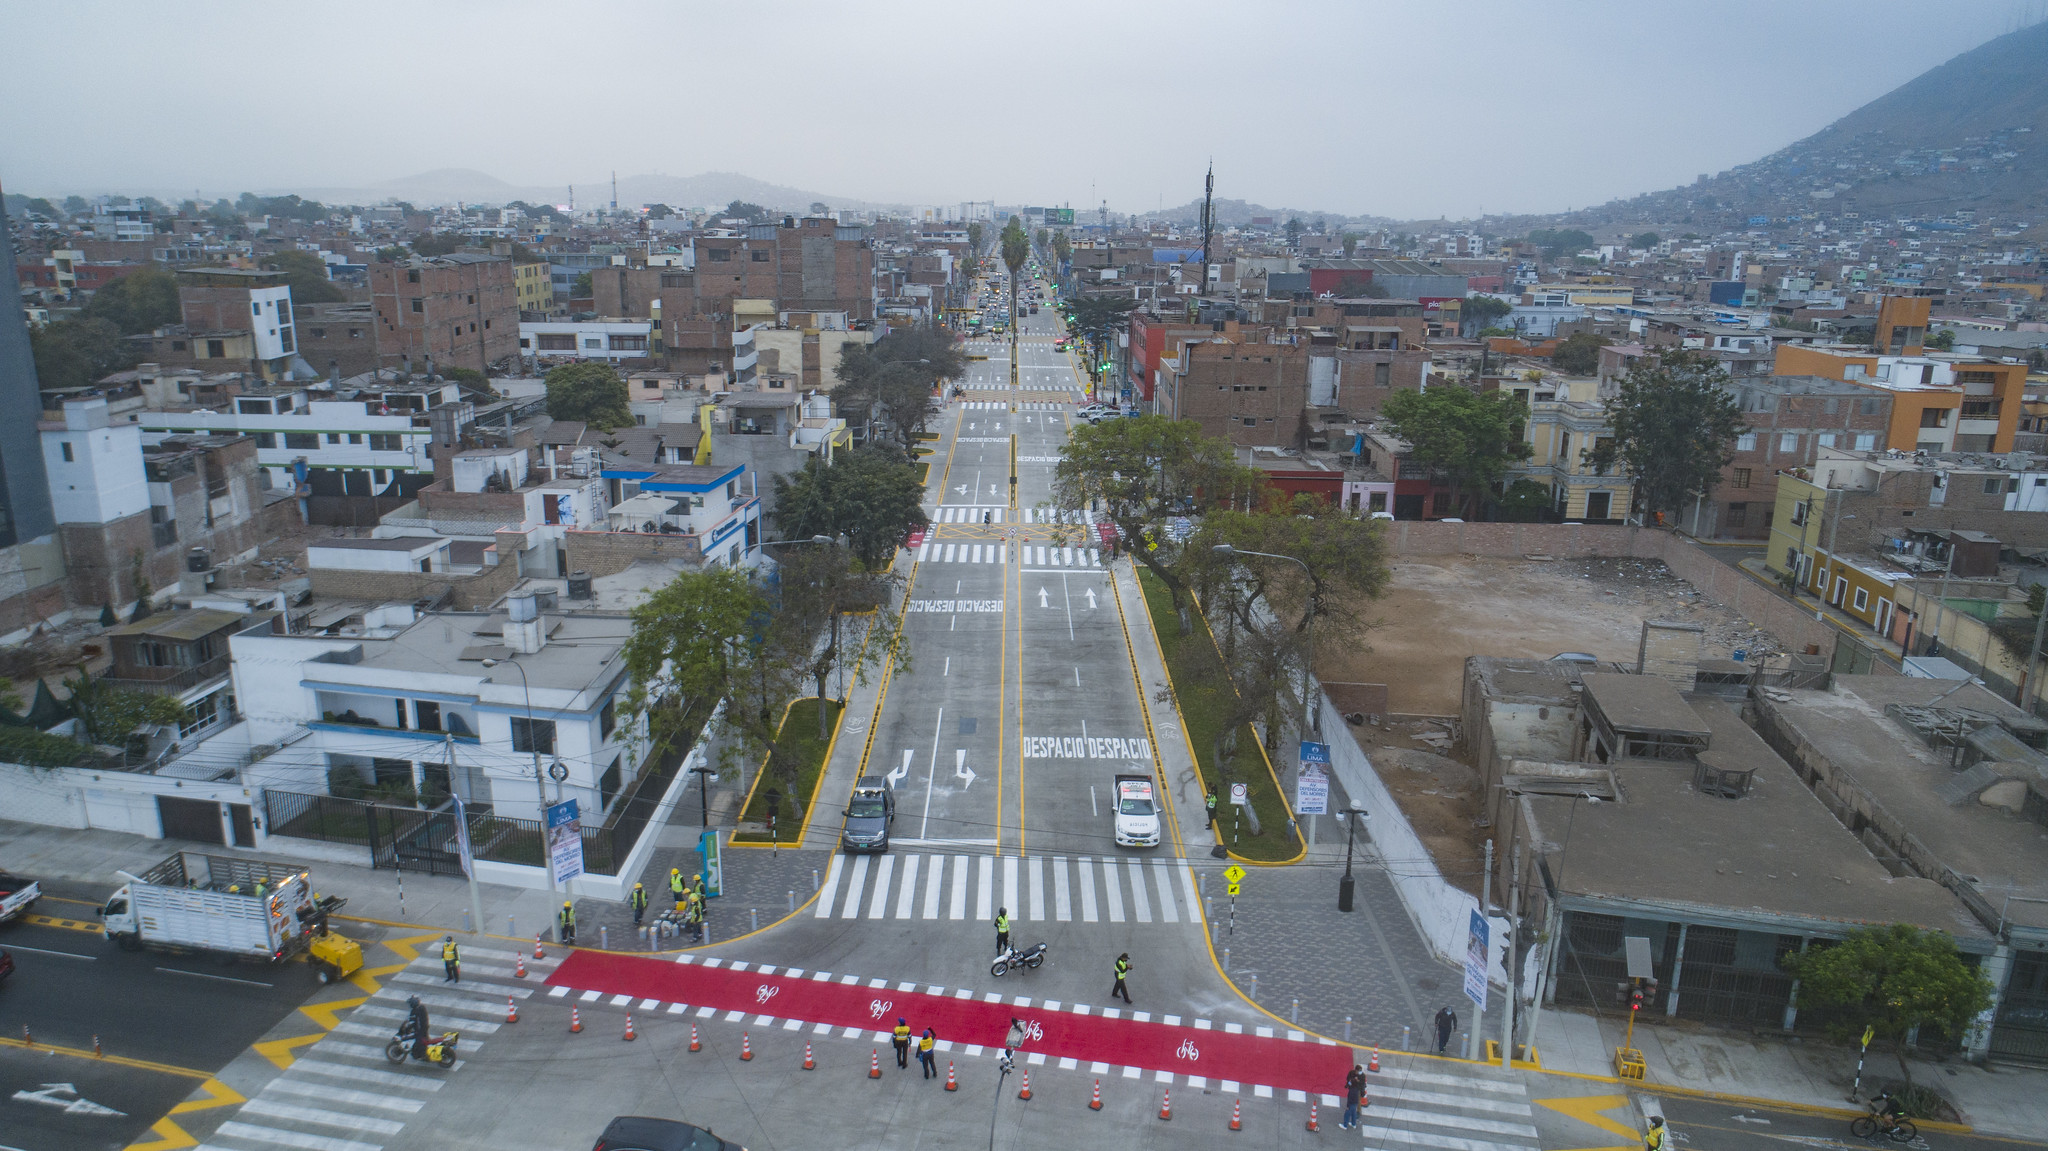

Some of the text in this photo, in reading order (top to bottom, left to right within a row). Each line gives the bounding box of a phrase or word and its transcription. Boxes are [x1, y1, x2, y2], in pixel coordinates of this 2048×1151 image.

[1428, 301, 1440, 309] pla
[907, 600, 1003, 613] DESPACIO DESPACIO
[1023, 737, 1152, 759] DESPACIO DESPACIO
